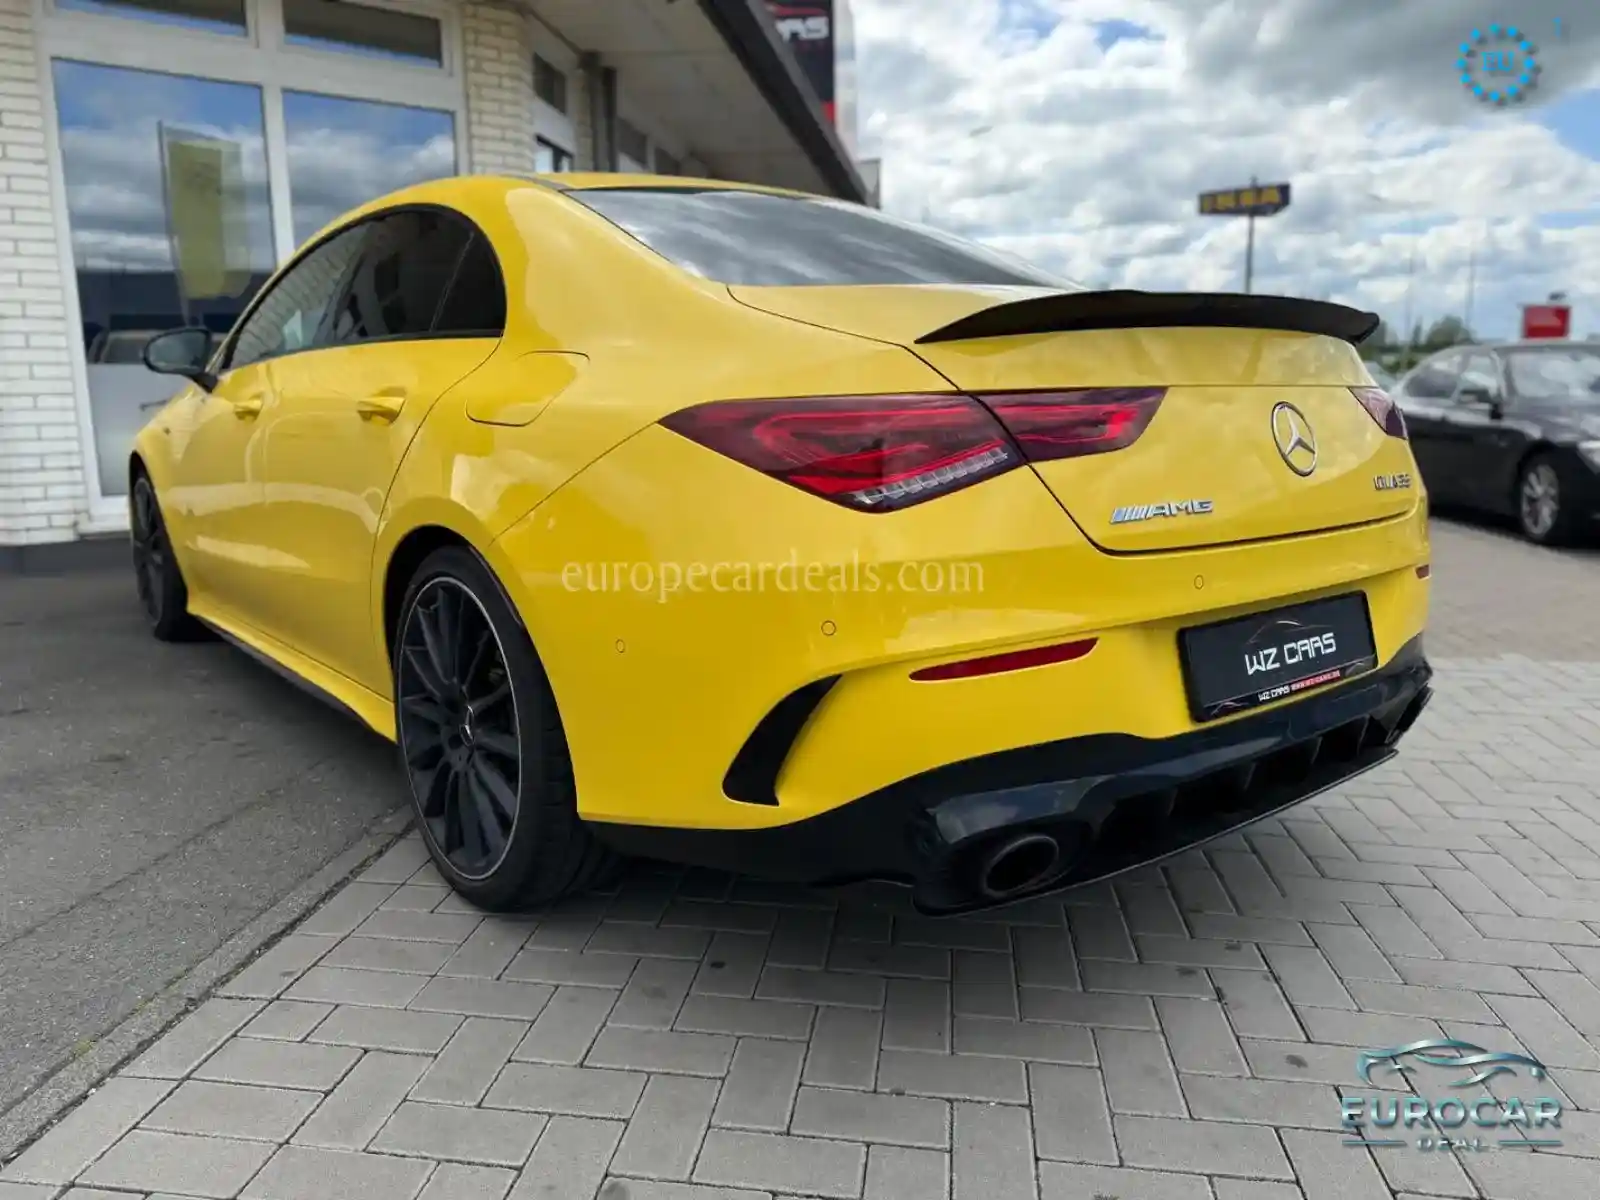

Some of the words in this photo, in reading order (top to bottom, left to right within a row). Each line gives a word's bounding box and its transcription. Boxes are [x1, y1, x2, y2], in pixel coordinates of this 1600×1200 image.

[1146, 499, 1213, 520] AMG
[1245, 648, 1280, 675] WZ
[1284, 632, 1337, 664] CARS
